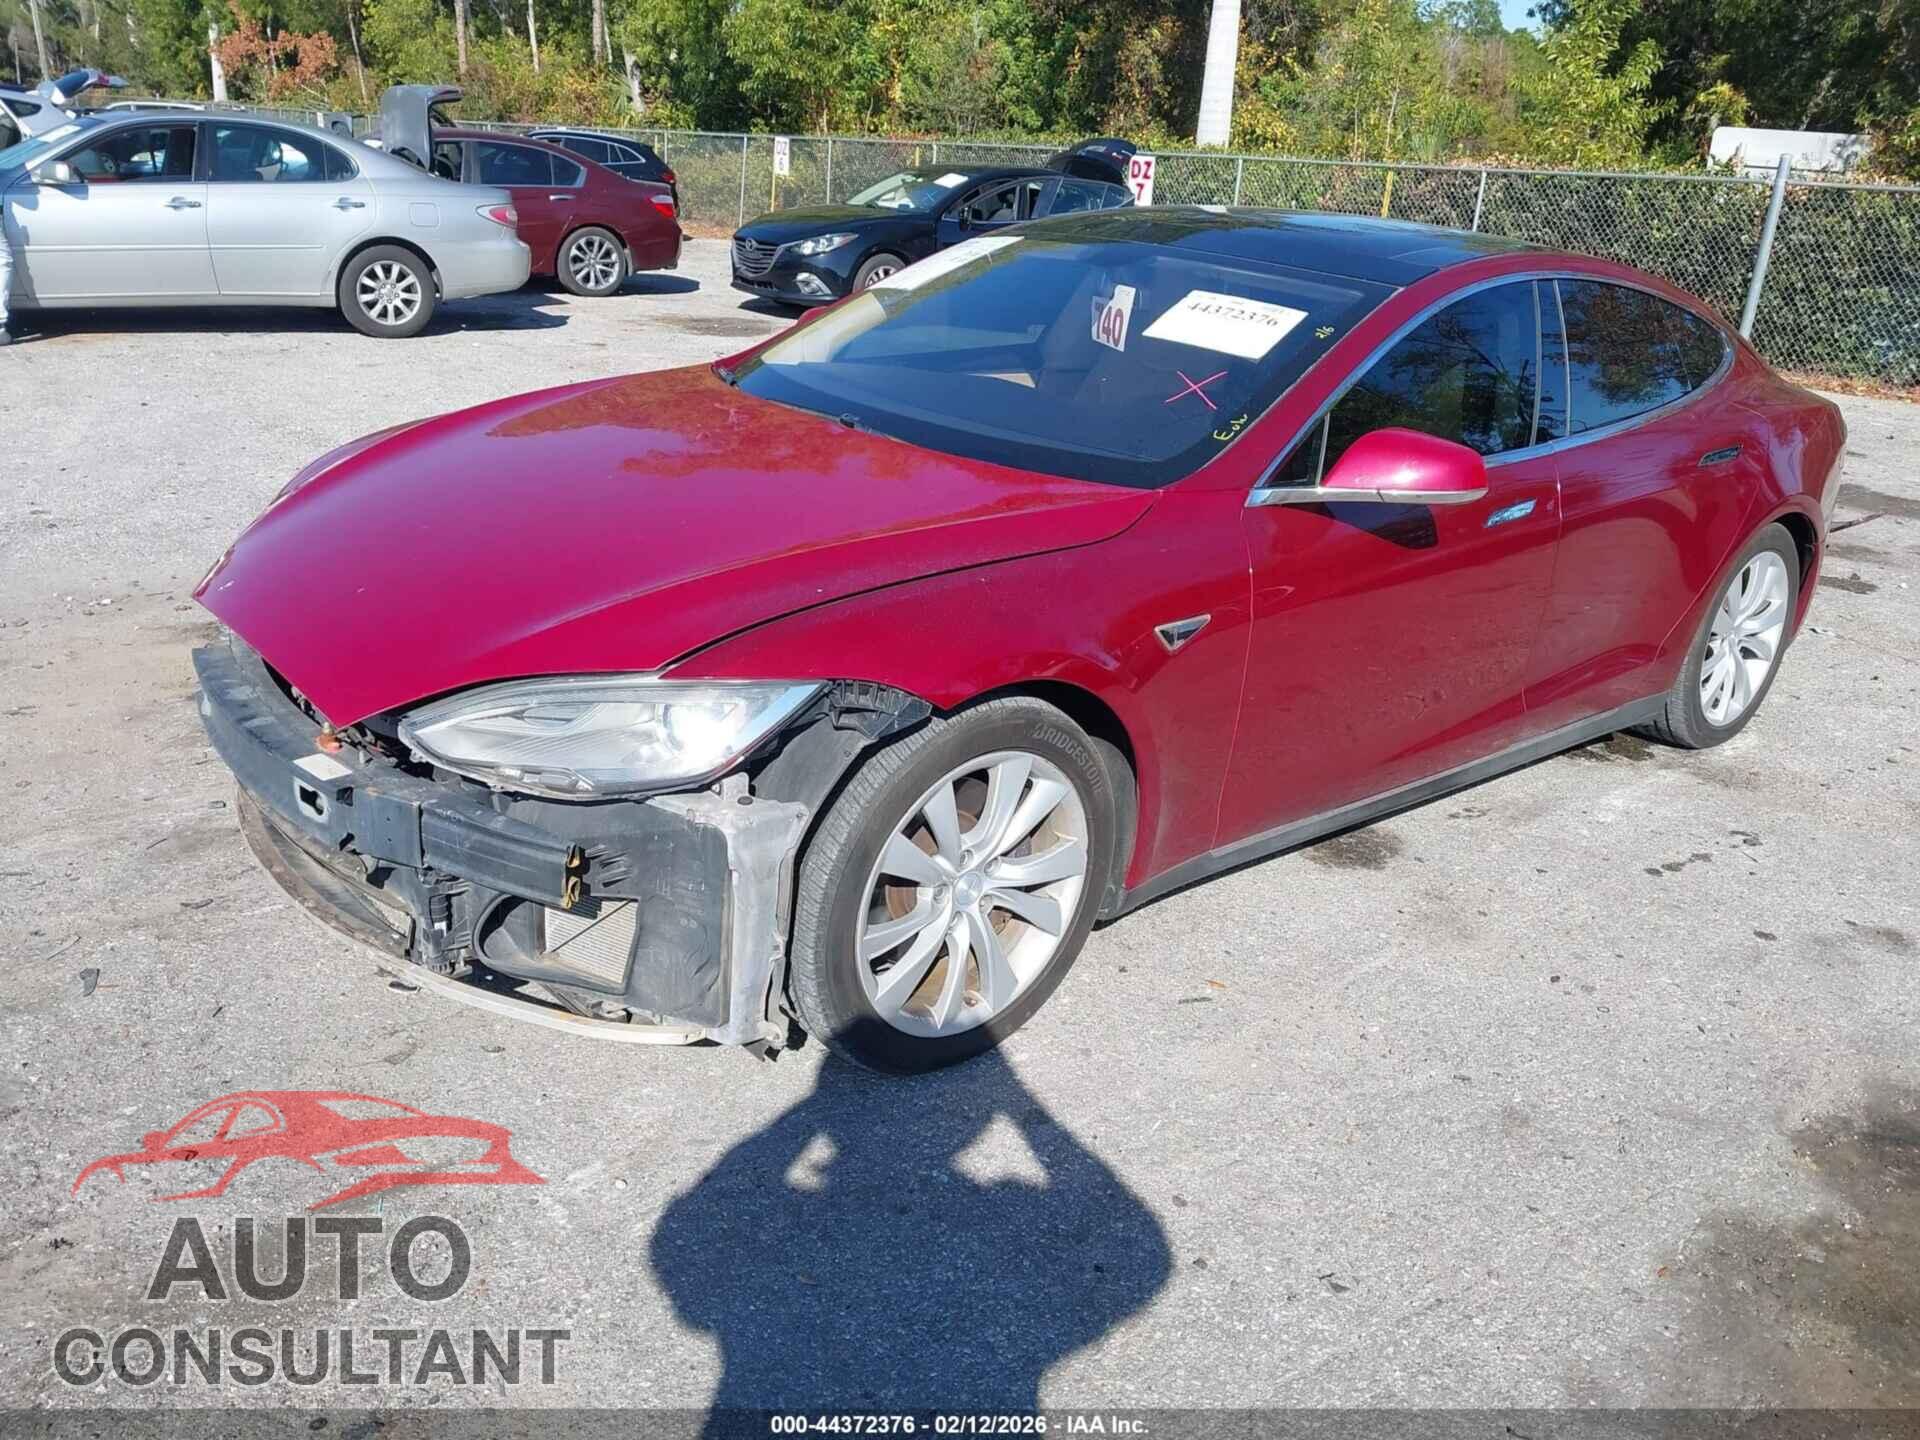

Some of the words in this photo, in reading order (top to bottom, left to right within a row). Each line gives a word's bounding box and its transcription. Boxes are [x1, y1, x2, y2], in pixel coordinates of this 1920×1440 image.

[1131, 160, 1152, 179] DZ
[1136, 183, 1145, 201] 7
[1031, 722, 1105, 794] BRIDGESTONE
